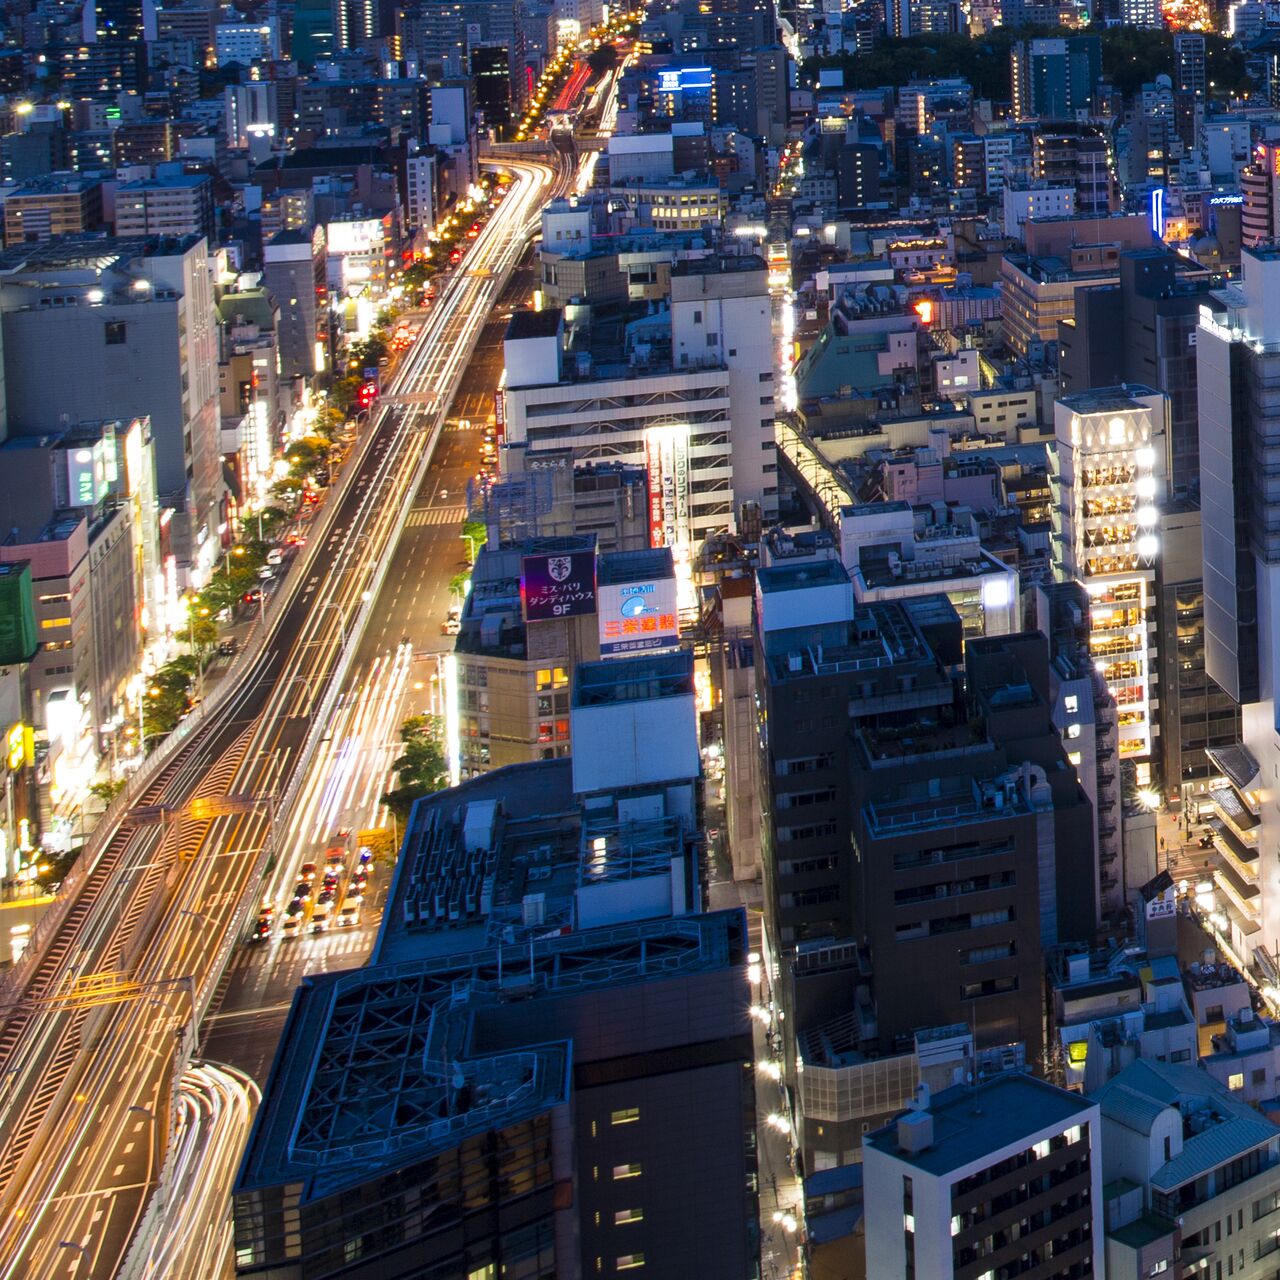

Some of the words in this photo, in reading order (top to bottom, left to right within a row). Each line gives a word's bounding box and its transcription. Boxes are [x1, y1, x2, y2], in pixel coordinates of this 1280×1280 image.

[540, 582, 581, 594] ミス・パリ
[529, 590, 595, 607] ダンディハウス
[552, 603, 571, 616] 9F
[604, 613, 675, 638] 三栄建設
